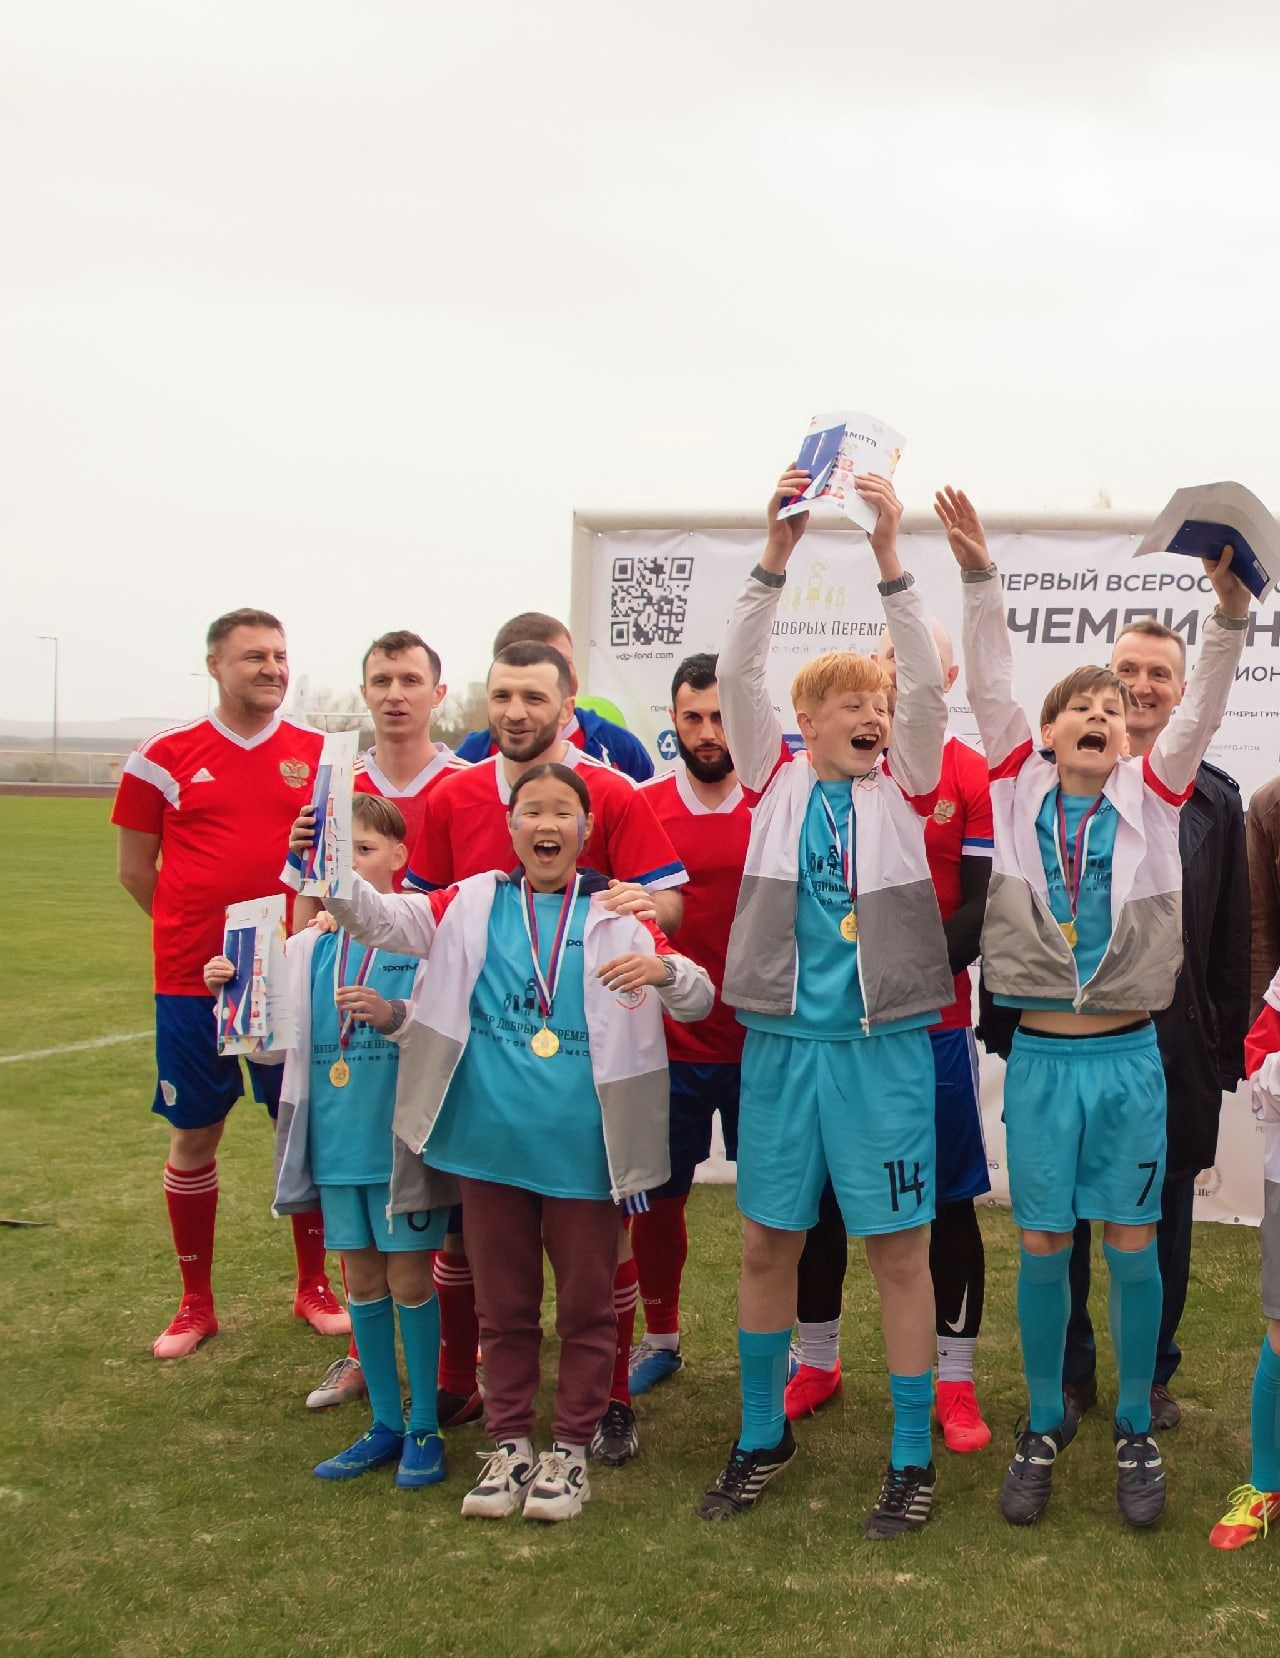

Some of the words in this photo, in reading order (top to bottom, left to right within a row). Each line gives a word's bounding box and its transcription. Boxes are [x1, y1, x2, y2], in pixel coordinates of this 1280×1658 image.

[831, 620, 887, 637] ПЕРЕМЕ
[883, 1160, 925, 1212] 14
[1136, 1161, 1158, 1207] 7
